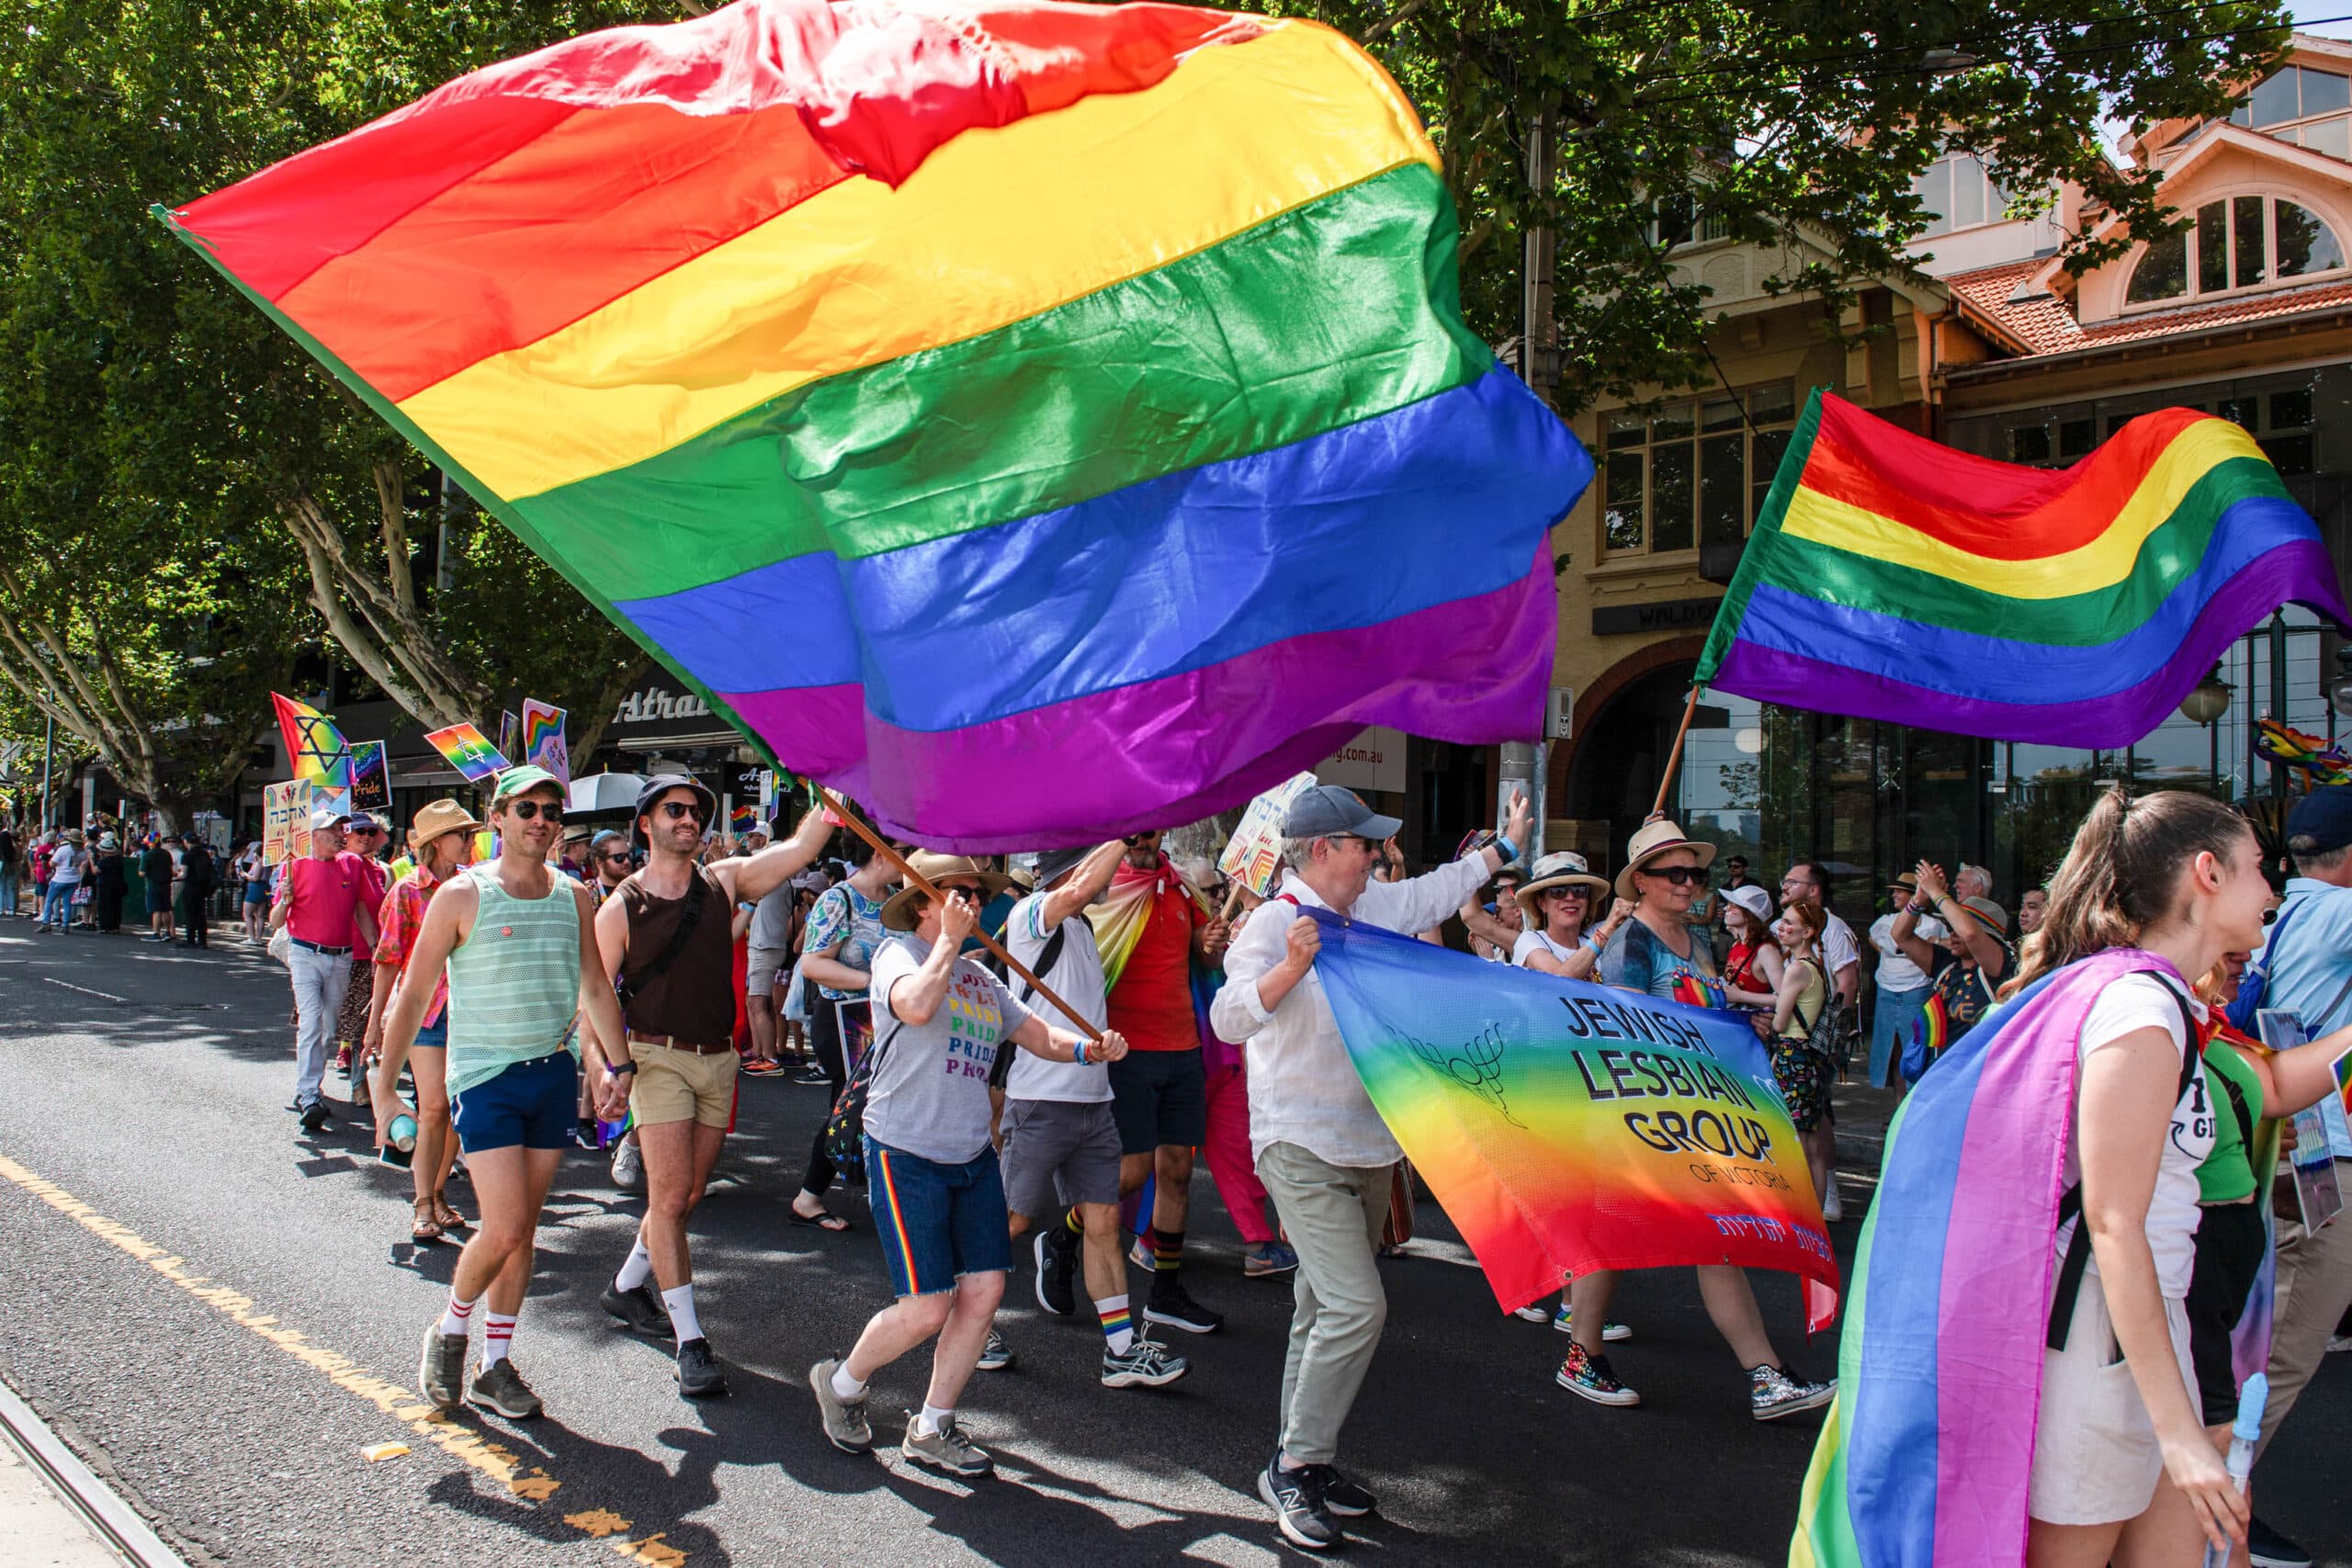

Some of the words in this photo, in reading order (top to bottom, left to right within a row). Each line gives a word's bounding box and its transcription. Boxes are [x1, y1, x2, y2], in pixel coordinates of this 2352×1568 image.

[1639, 601, 1720, 626] WALDO
[1331, 748, 1383, 763] g.com.au
[354, 781, 381, 795] Pride
[270, 805, 307, 825] אהבה
[1948, 1002, 1975, 1021] VE
[1559, 997, 1719, 1060] JEWISH
[1571, 1050, 1760, 1113] LESBIAN
[1623, 1110, 1776, 1166] GROUP
[1690, 1164, 1718, 1183] OF
[1717, 1167, 1793, 1192] VICTORIA
